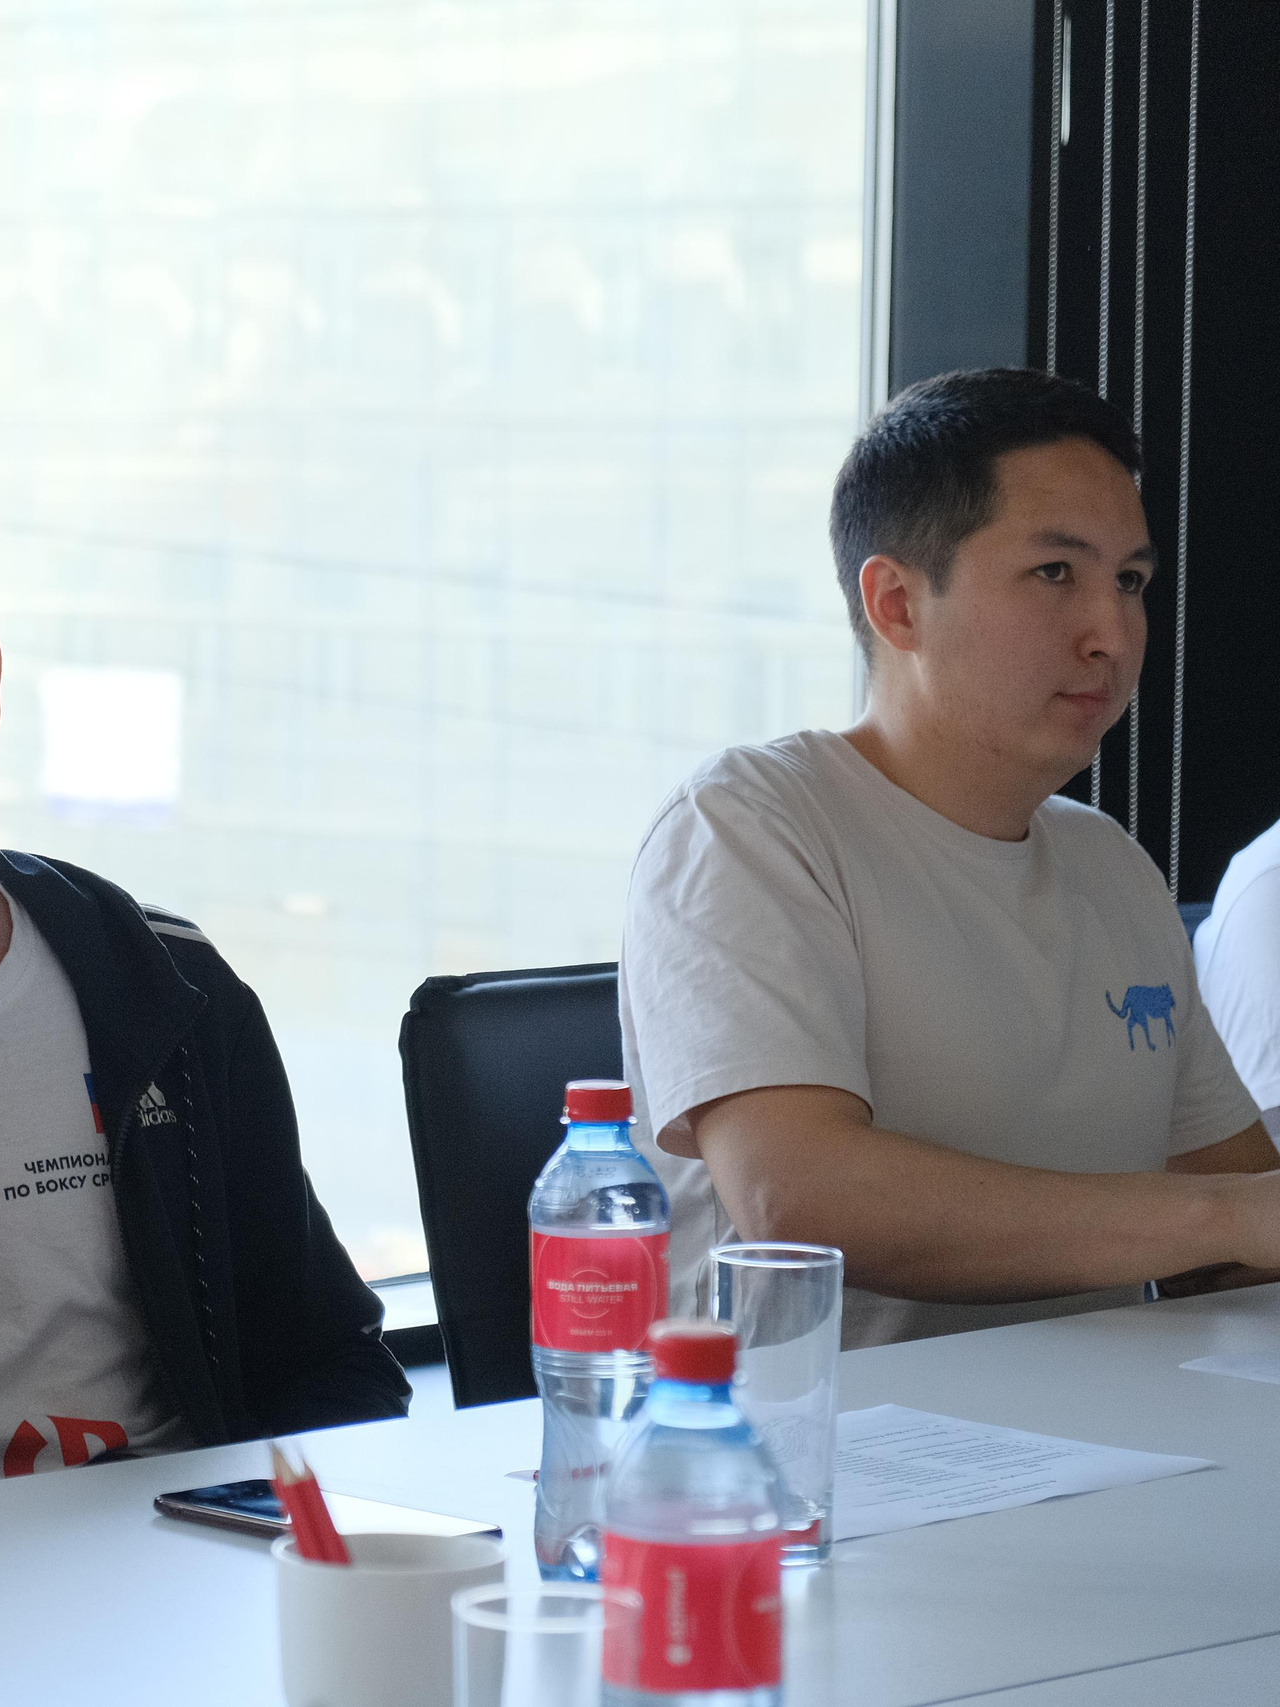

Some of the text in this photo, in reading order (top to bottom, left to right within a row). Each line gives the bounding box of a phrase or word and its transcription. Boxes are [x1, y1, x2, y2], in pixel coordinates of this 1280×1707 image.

[3, 1173, 111, 1201] ПО БОКСУ СР
[548, 1280, 638, 1293] ВОДА ПИТЬЕВАЯ
[560, 1294, 623, 1304] STILL WATER
